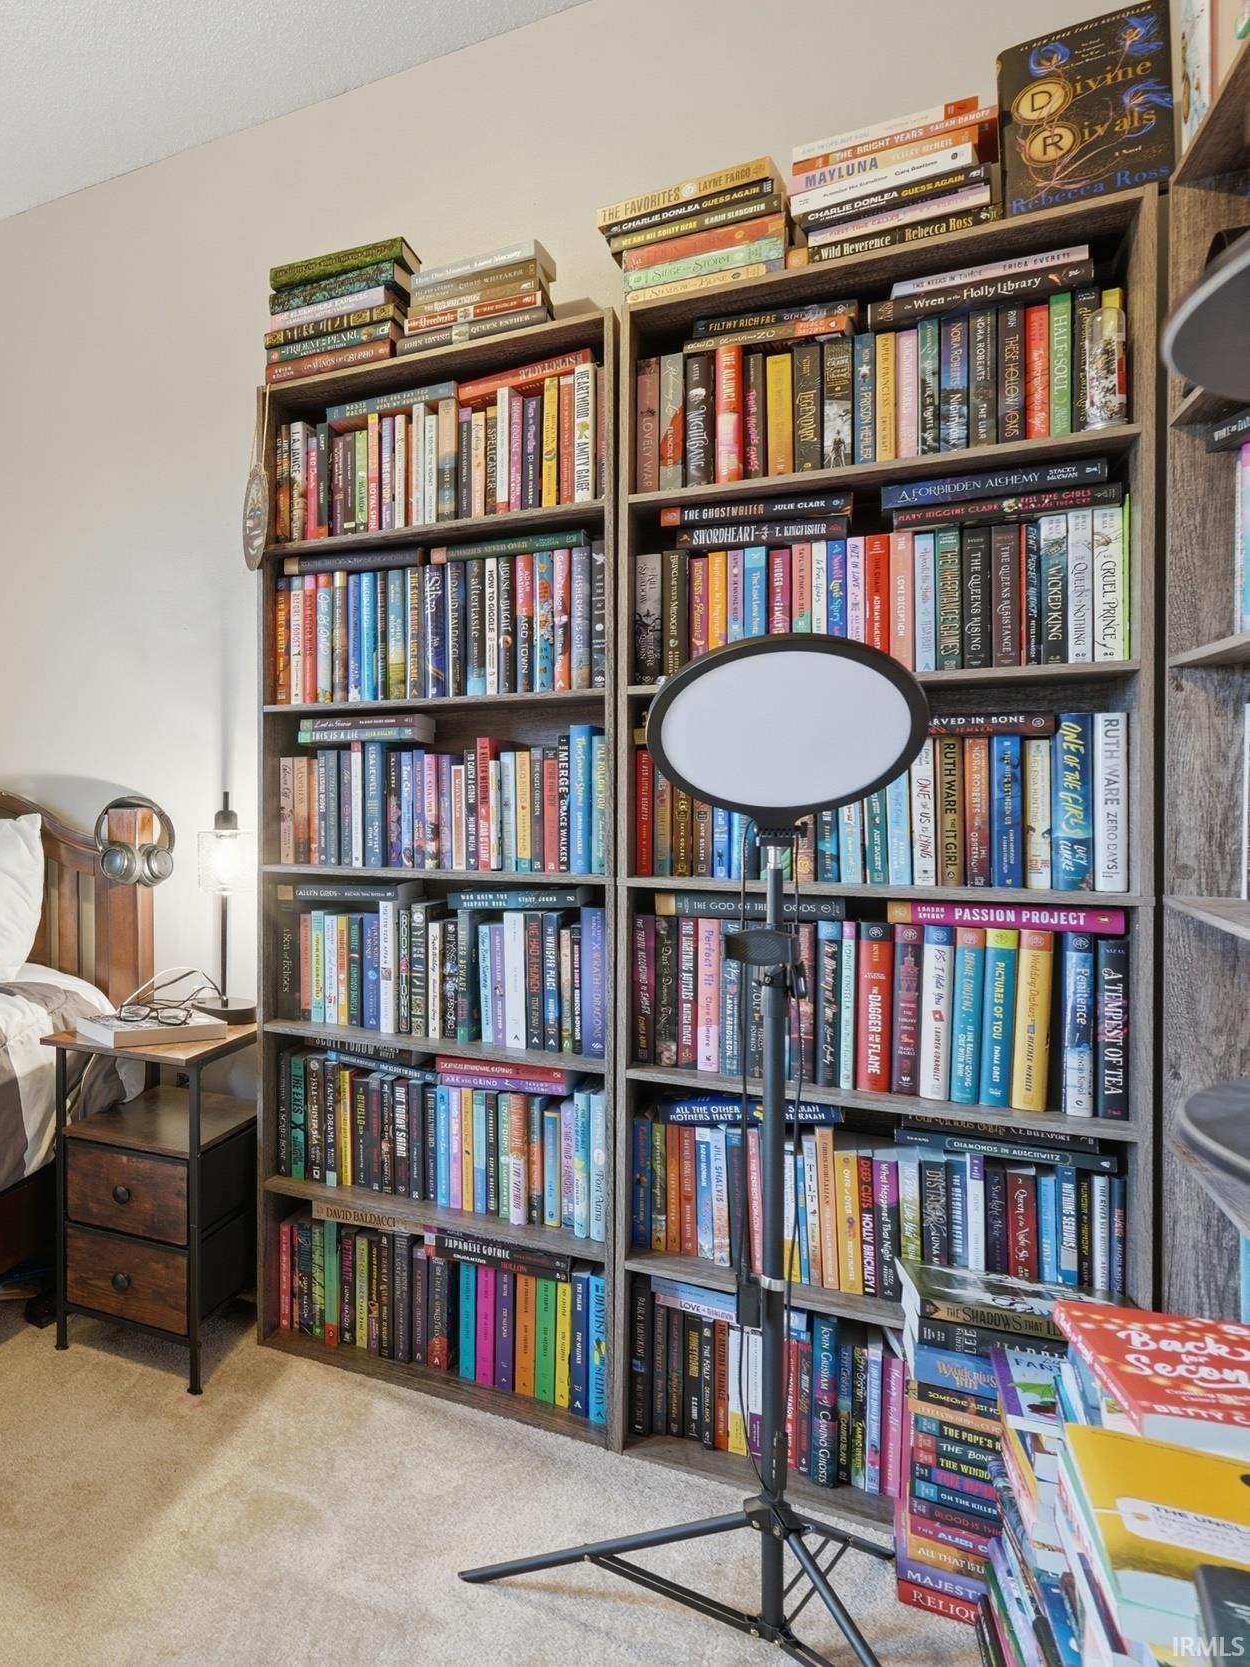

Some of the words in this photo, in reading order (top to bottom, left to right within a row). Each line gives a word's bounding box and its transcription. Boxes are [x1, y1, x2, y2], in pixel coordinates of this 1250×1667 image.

[1030, 60, 1152, 113] Divine
[1042, 110, 1157, 156] Rivals
[805, 156, 879, 188] MAYLUNA
[602, 207, 621, 222] THE
[624, 187, 680, 218] FAVORITES
[622, 213, 661, 230] CHARLIE
[662, 203, 700, 219] DONLEA
[808, 203, 853, 221] CHARLIE
[854, 191, 899, 210] DONLEA
[905, 221, 947, 242] Rebecca
[950, 215, 974, 232] Ross
[820, 245, 841, 260] Wild
[844, 235, 891, 255] Reverence
[914, 297, 944, 309] Wren
[964, 285, 995, 299] Holly
[998, 277, 1041, 295] Library
[709, 320, 738, 332] FILTHY
[739, 318, 760, 328] RICH
[761, 315, 777, 325] FAE
[950, 322, 963, 349] NORA
[976, 316, 985, 341] NORA
[1053, 315, 1068, 350] HALF
[976, 343, 986, 381] ROBERTS
[1004, 335, 1018, 362] THESE
[950, 350, 963, 386] ROBERTS
[1053, 358, 1068, 395] SOUL
[576, 370, 590, 419] HEARTWOOD
[1004, 364, 1019, 405] HOLLOW
[797, 390, 817, 444] LEGENDARY
[859, 391, 872, 425] PRISON
[948, 394, 962, 446] NIGHTWORK
[1005, 408, 1019, 437] VOWS
[641, 417, 654, 460] LOVELY
[859, 426, 872, 461] HEALER
[487, 428, 497, 490] SPELLCASTER
[576, 442, 589, 467] AMITY
[576, 469, 590, 492] GAIGE
[643, 462, 654, 487] WAR
[684, 509, 699, 520] THE
[702, 504, 764, 519] GHOSTWRITER
[773, 502, 794, 511] JULIE
[797, 500, 826, 508] CLARK
[898, 512, 924, 521] MARY
[968, 503, 999, 513] CLARK
[692, 525, 756, 545] SWORDHEART
[784, 523, 827, 536] KINGFISHER
[940, 547, 959, 565] THE
[971, 552, 982, 573] THE
[1000, 546, 1011, 563] THE
[998, 565, 1011, 598] QUEENS
[1047, 565, 1063, 610] WICKED
[1073, 562, 1091, 598] QUEEN
[1100, 560, 1118, 598] CRUEL
[488, 591, 495, 602] TO
[940, 568, 960, 622] INHERITANCE
[969, 574, 982, 614] QUEENS
[520, 607, 528, 638] HARD
[965, 617, 982, 651] RISING
[996, 600, 1012, 653] RESISTANCE
[1045, 611, 1063, 641] KING
[1072, 603, 1089, 646] NOTHING
[1101, 598, 1120, 641] PRINCE
[940, 624, 960, 655] GAMES
[311, 730, 327, 740] THIS
[329, 731, 338, 739] IS
[348, 730, 359, 739] LIE
[1061, 722, 1085, 754] ONE
[1104, 719, 1121, 760] RUTH
[559, 751, 568, 793] MERGE
[944, 743, 957, 777] RUTH
[1064, 754, 1079, 768] OF
[916, 778, 931, 800] ONE
[1064, 770, 1081, 789] THE
[1104, 764, 1121, 805] WARE
[944, 779, 957, 814] WARE
[919, 812, 931, 824] US
[1059, 791, 1086, 835] GIRLS
[1105, 812, 1118, 841] ZERO
[918, 834, 932, 859] LYING
[944, 829, 957, 841] IT
[945, 842, 958, 869] GIRL
[1060, 840, 1077, 871] CLARKE
[1075, 845, 1087, 864] LUCY
[1105, 843, 1119, 870] DAYS
[755, 903, 769, 911] THE
[783, 904, 816, 913] OODS
[954, 908, 1016, 922] PASSION
[1022, 910, 1086, 925] PROJECT
[283, 934, 292, 950] Sea
[681, 922, 694, 935] THE
[546, 936, 556, 967] WHISPER
[681, 936, 694, 971] LIGHTNING
[282, 960, 293, 992] Echoes
[547, 970, 556, 990] PLACE
[995, 961, 1005, 1004] PICTURES
[1102, 968, 1122, 980] A
[1076, 967, 1090, 1025] Penitence
[994, 1006, 1002, 1019] OF
[1104, 984, 1123, 1044] TEMPEST
[992, 1021, 1002, 1040] YOU
[1104, 1048, 1123, 1065] OF
[395, 1087, 405, 1102] NOT
[1104, 1069, 1123, 1095] TEA
[327, 1114, 335, 1143] DRAMA
[396, 1105, 406, 1130] TODAY
[396, 1131, 406, 1157] SATAN
[881, 1164, 889, 1183] What
[326, 1208, 352, 1221] DAVID
[353, 1212, 396, 1227] BALDACCI
[878, 1185, 890, 1221] Happened
[862, 1213, 873, 1242] HOLLY
[883, 1224, 891, 1239] That
[342, 1239, 352, 1283] DETONATE
[445, 1238, 480, 1253] JAPANESE
[482, 1244, 510, 1259] GOTHIC
[881, 1241, 893, 1261] Night
[864, 1245, 875, 1286] BRICKLEY
[946, 1306, 961, 1319] THE
[961, 1307, 1022, 1330] SHADOWS
[1024, 1321, 1043, 1332] THAT
[821, 1326, 833, 1349] JOHN
[1116, 1330, 1250, 1361] Back
[820, 1352, 832, 1390] GRISHAM
[1125, 1354, 1250, 1385] Secon
[1181, 1353, 1209, 1363] for
[1153, 1404, 1223, 1421] BETTY
[818, 1411, 832, 1447] CAMINO
[943, 1425, 960, 1440] THE
[961, 1429, 993, 1448] POPE'S
[941, 1443, 964, 1454] THE
[818, 1449, 831, 1483] GHOSTS
[917, 1547, 934, 1559] ALL
[937, 1552, 965, 1567] THAT
[907, 1570, 983, 1600] MAJEST
